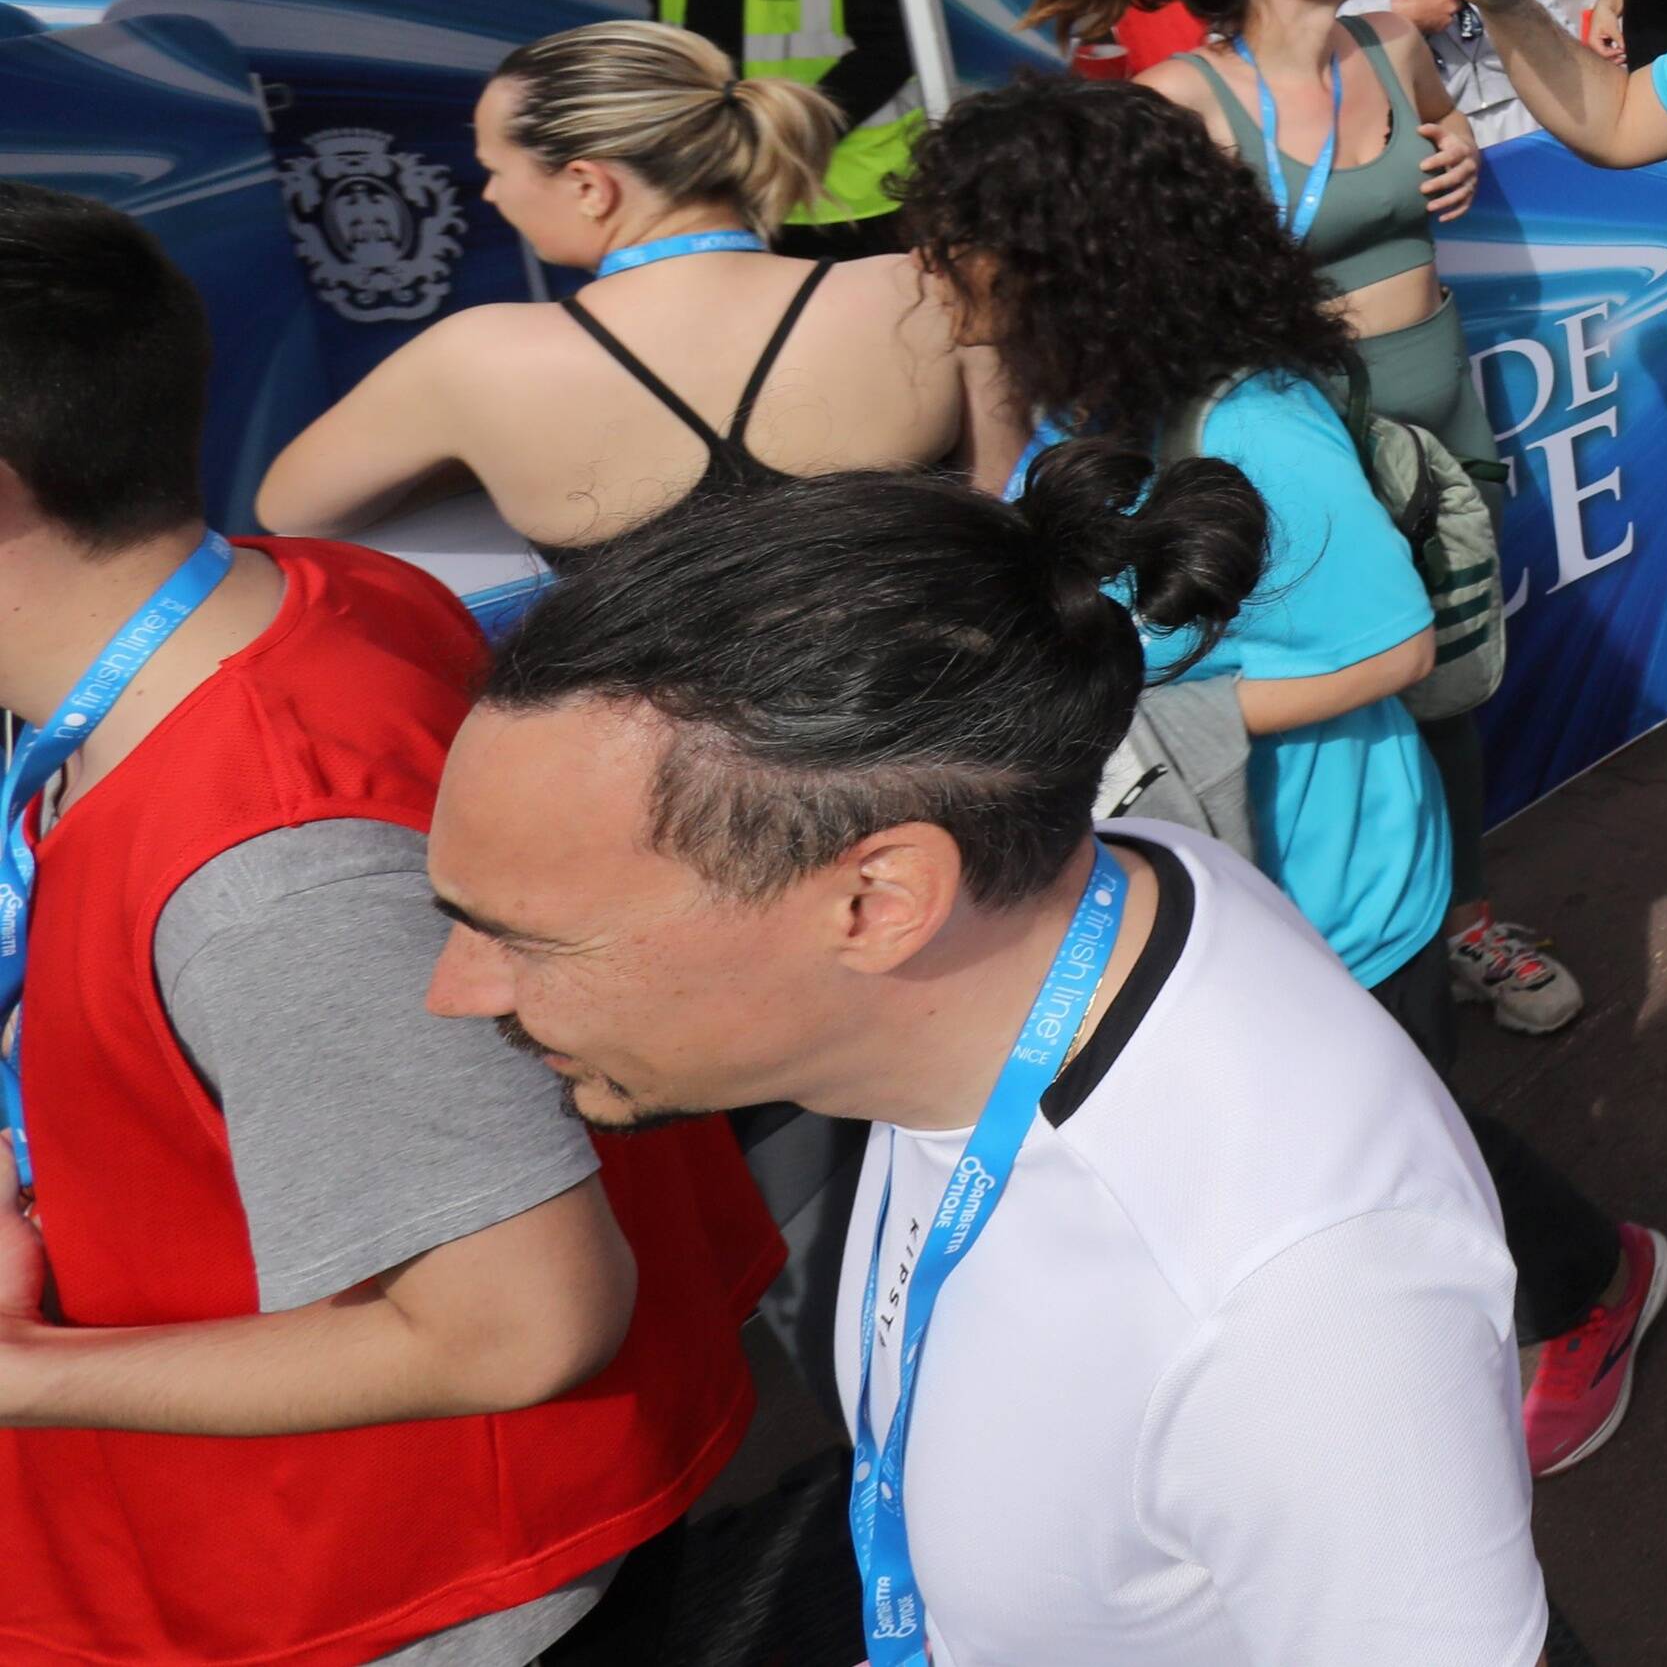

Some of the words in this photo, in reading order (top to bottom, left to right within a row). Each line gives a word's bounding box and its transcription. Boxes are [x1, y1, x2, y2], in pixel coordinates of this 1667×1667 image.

[1466, 299, 1622, 442] DE
[1501, 405, 1636, 622] E
[73, 645, 132, 710] finish
[123, 608, 167, 665] line
[1094, 875, 1119, 910] no
[1062, 907, 1109, 994] finish
[1012, 1042, 1050, 1069] NICE
[1034, 986, 1092, 1048] line
[935, 1152, 981, 1234] OPTIQUE
